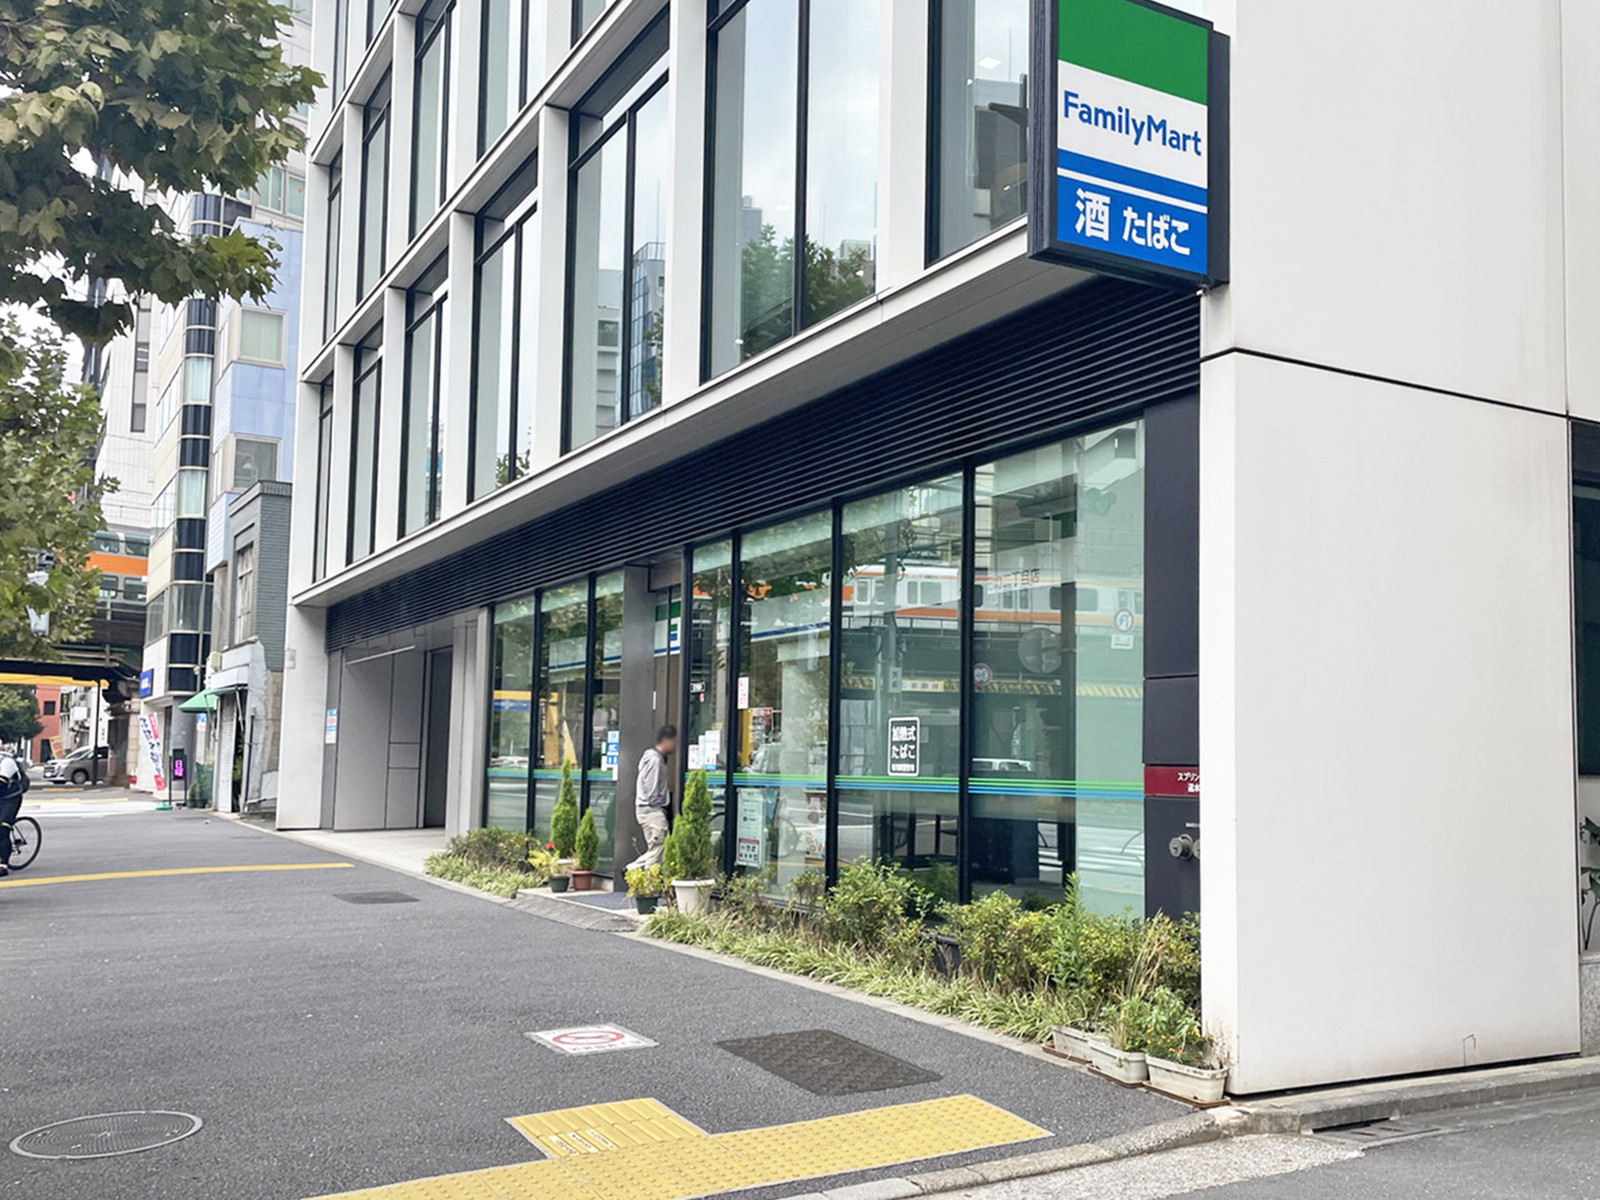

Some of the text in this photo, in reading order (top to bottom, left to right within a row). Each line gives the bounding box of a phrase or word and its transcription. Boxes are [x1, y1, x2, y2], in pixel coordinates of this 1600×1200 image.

[1063, 90, 1202, 157] FamilyMart
[1075, 188, 1191, 256] 酒 たばこ
[891, 744, 916, 759] たばこ
